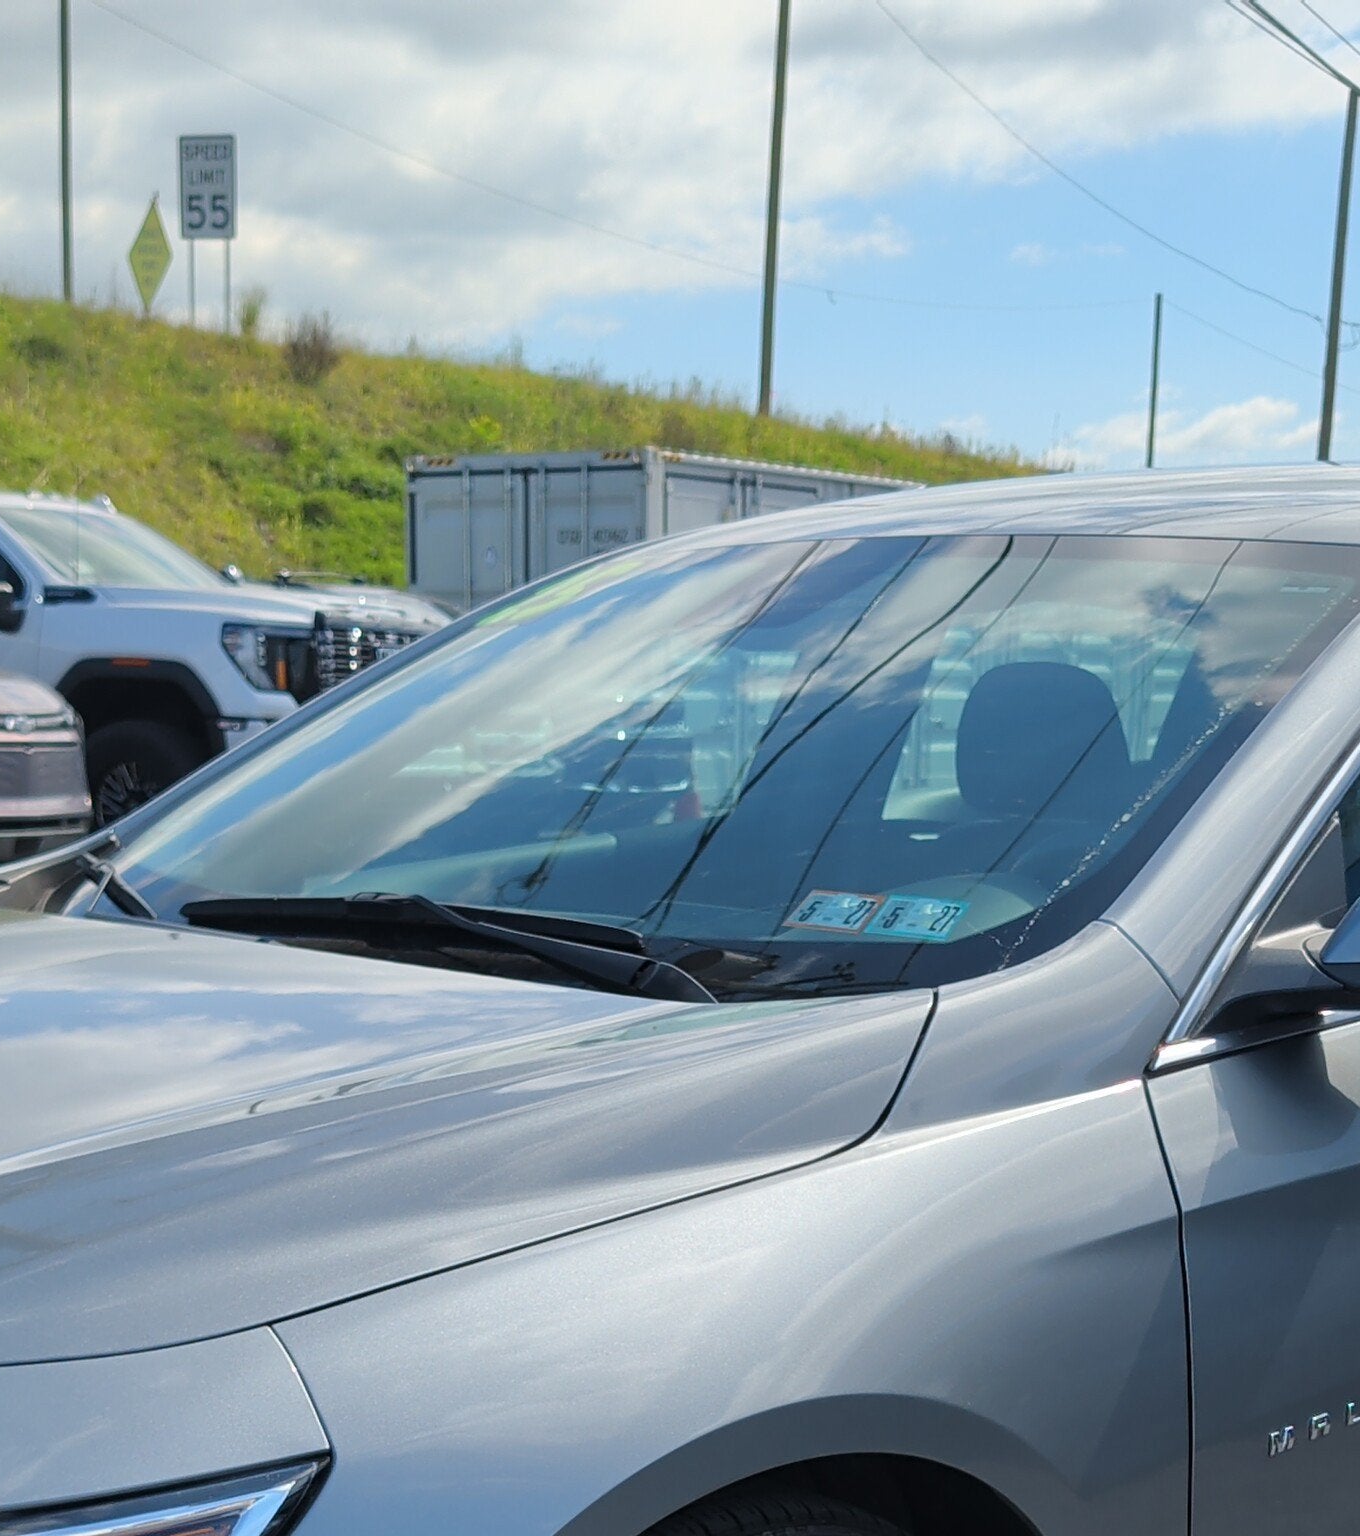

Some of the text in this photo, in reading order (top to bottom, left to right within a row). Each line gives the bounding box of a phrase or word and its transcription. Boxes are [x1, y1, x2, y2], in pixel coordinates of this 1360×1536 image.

[183, 144, 231, 161] SPEED
[189, 168, 225, 184] LIMIT
[187, 194, 230, 229] 55
[798, 900, 877, 927] 5 27
[882, 905, 960, 932] 5 27
